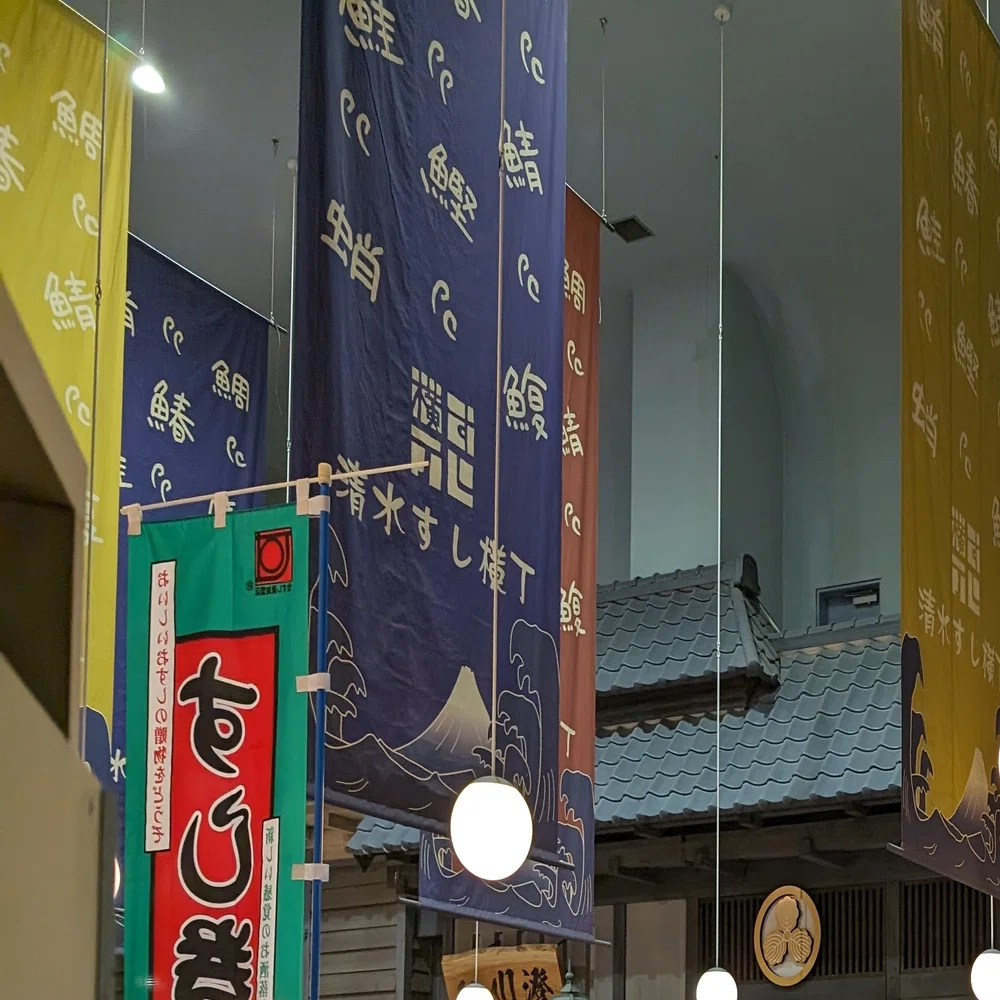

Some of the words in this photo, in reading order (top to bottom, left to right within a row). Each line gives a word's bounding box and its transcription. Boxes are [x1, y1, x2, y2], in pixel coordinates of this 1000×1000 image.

[51, 89, 103, 160] 鯛
[501, 120, 543, 195] 鯖
[420, 143, 478, 243] 鰹
[44, 271, 96, 332] 鯖
[147, 379, 195, 444] 鰆
[211, 360, 250, 412] 鯛
[336, 454, 535, 604] 清水すし横丁
